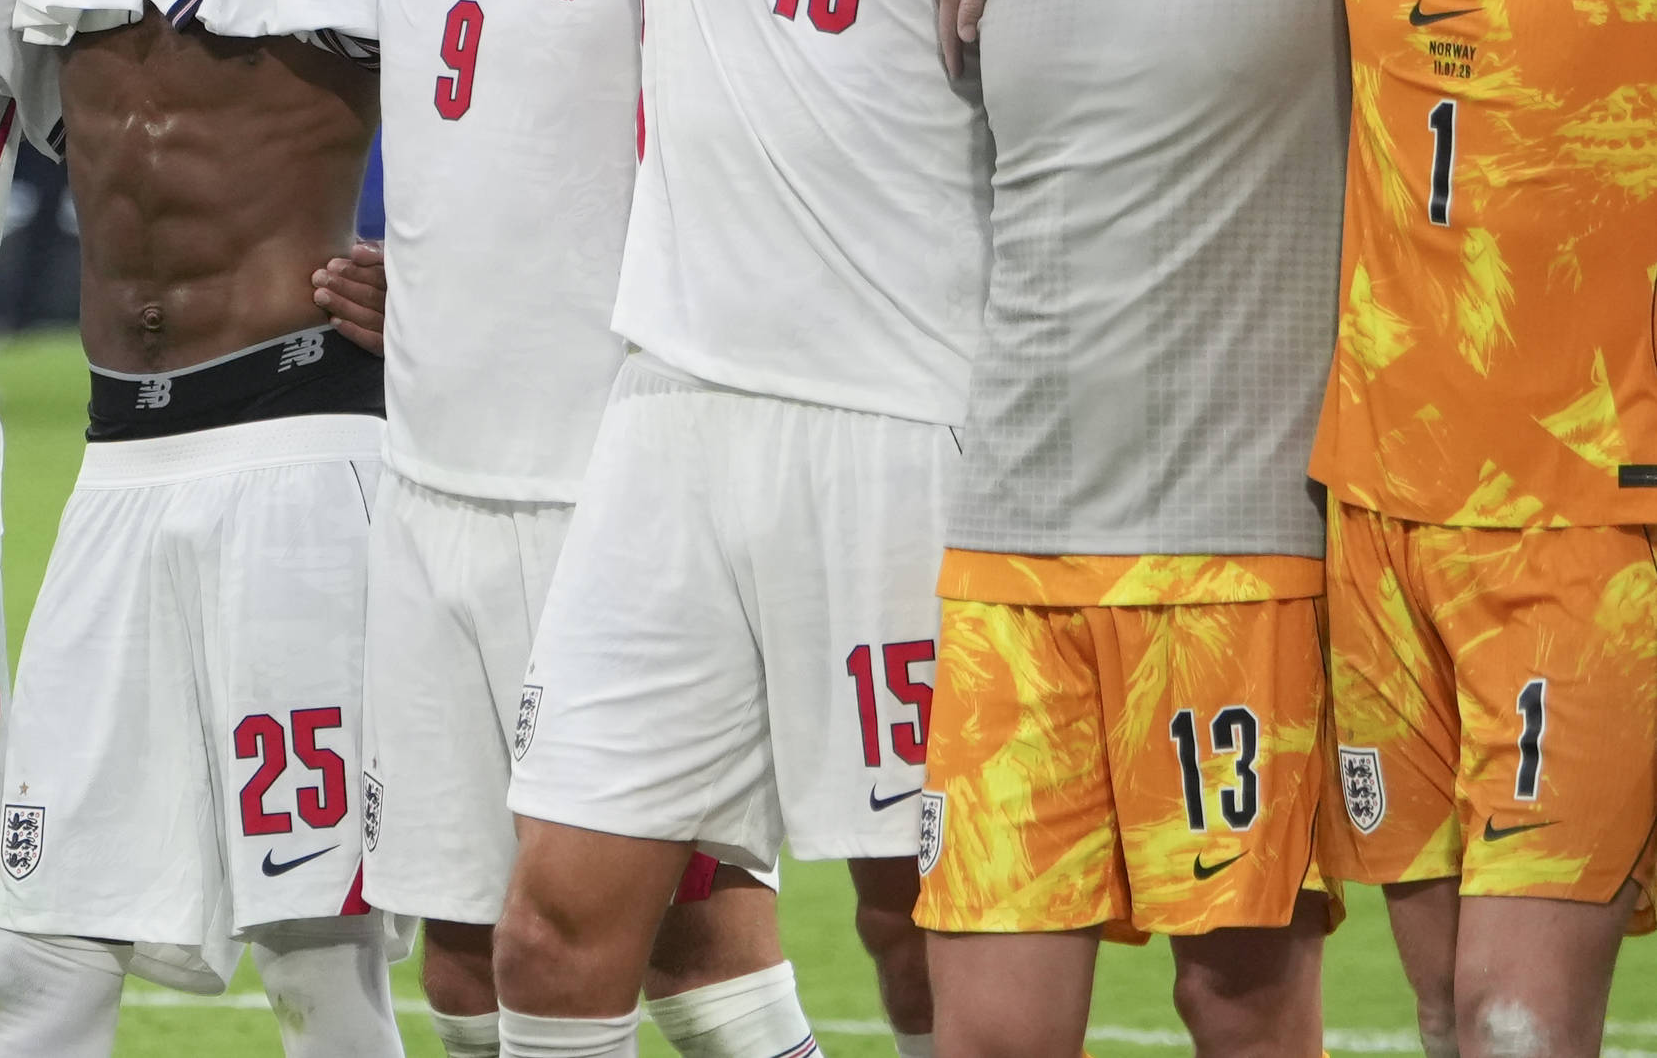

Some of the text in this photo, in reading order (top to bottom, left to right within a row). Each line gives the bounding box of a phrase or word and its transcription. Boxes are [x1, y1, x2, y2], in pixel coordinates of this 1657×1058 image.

[434, 0, 485, 121] 9
[1429, 41, 1477, 60] NORWAY
[1434, 60, 1472, 79] 11.07.26
[1428, 98, 1457, 228] 1
[845, 639, 936, 768] 15
[1514, 678, 1548, 801] 1
[233, 706, 348, 837] 25
[1169, 705, 1260, 833] 13
